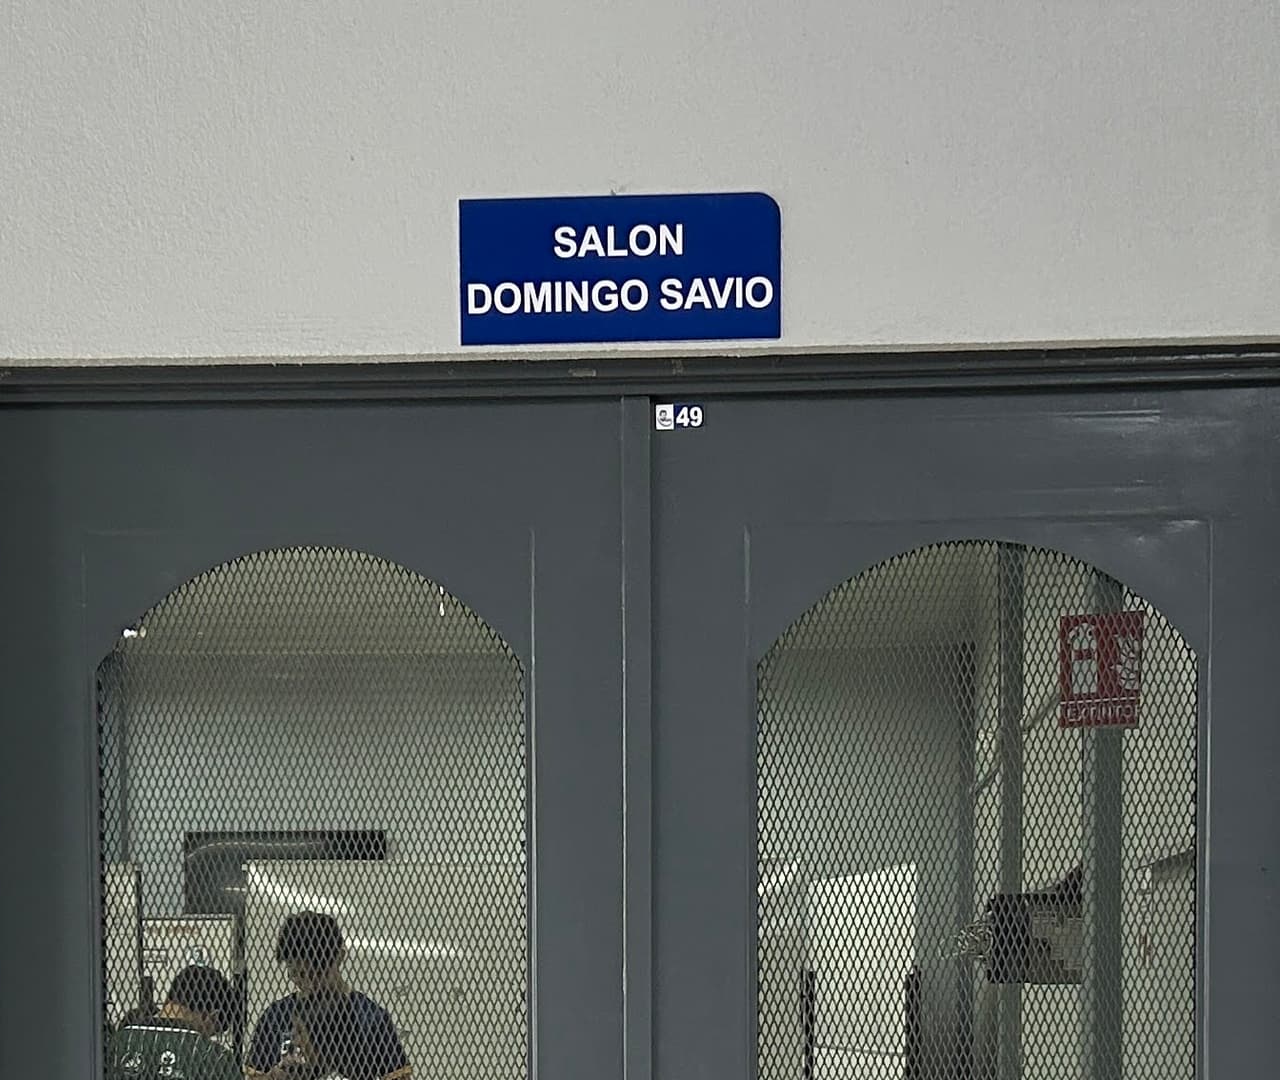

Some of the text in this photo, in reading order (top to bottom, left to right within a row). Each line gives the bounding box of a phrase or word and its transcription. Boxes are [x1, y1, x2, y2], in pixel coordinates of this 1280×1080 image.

[553, 223, 684, 258] SALON
[467, 276, 774, 316] DOMINGO SAVIO
[675, 406, 703, 427] 49
